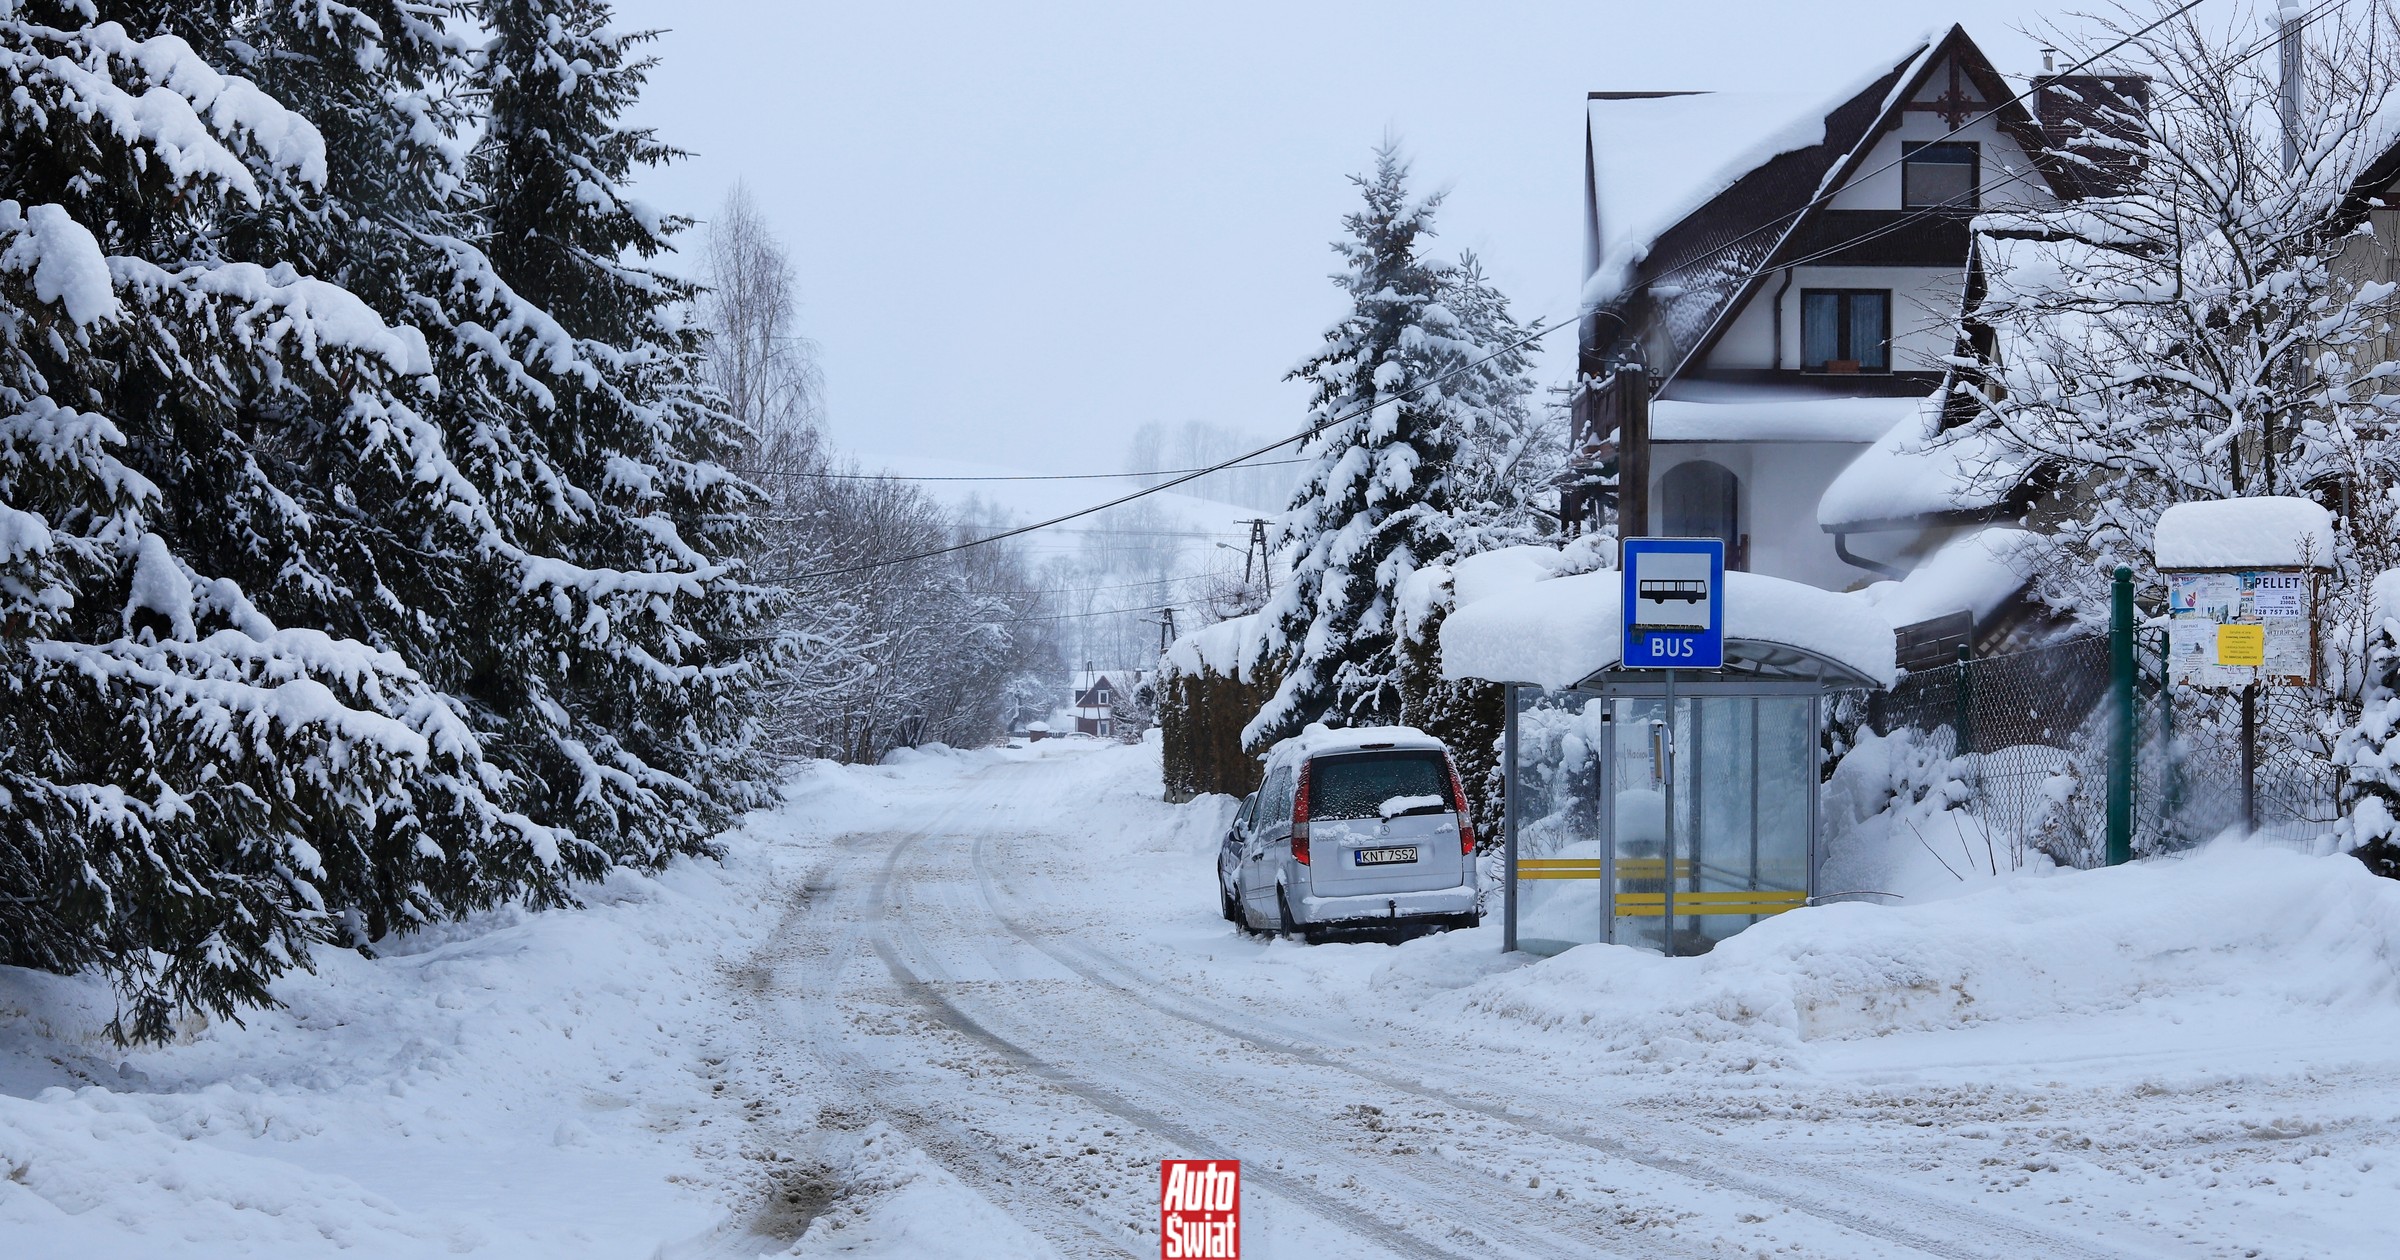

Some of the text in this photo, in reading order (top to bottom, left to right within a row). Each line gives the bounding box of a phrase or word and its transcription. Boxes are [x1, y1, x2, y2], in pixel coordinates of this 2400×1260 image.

[2255, 577, 2300, 588] PELLET
[1651, 637, 1694, 658] BUS
[1363, 851, 1384, 862] KNT
